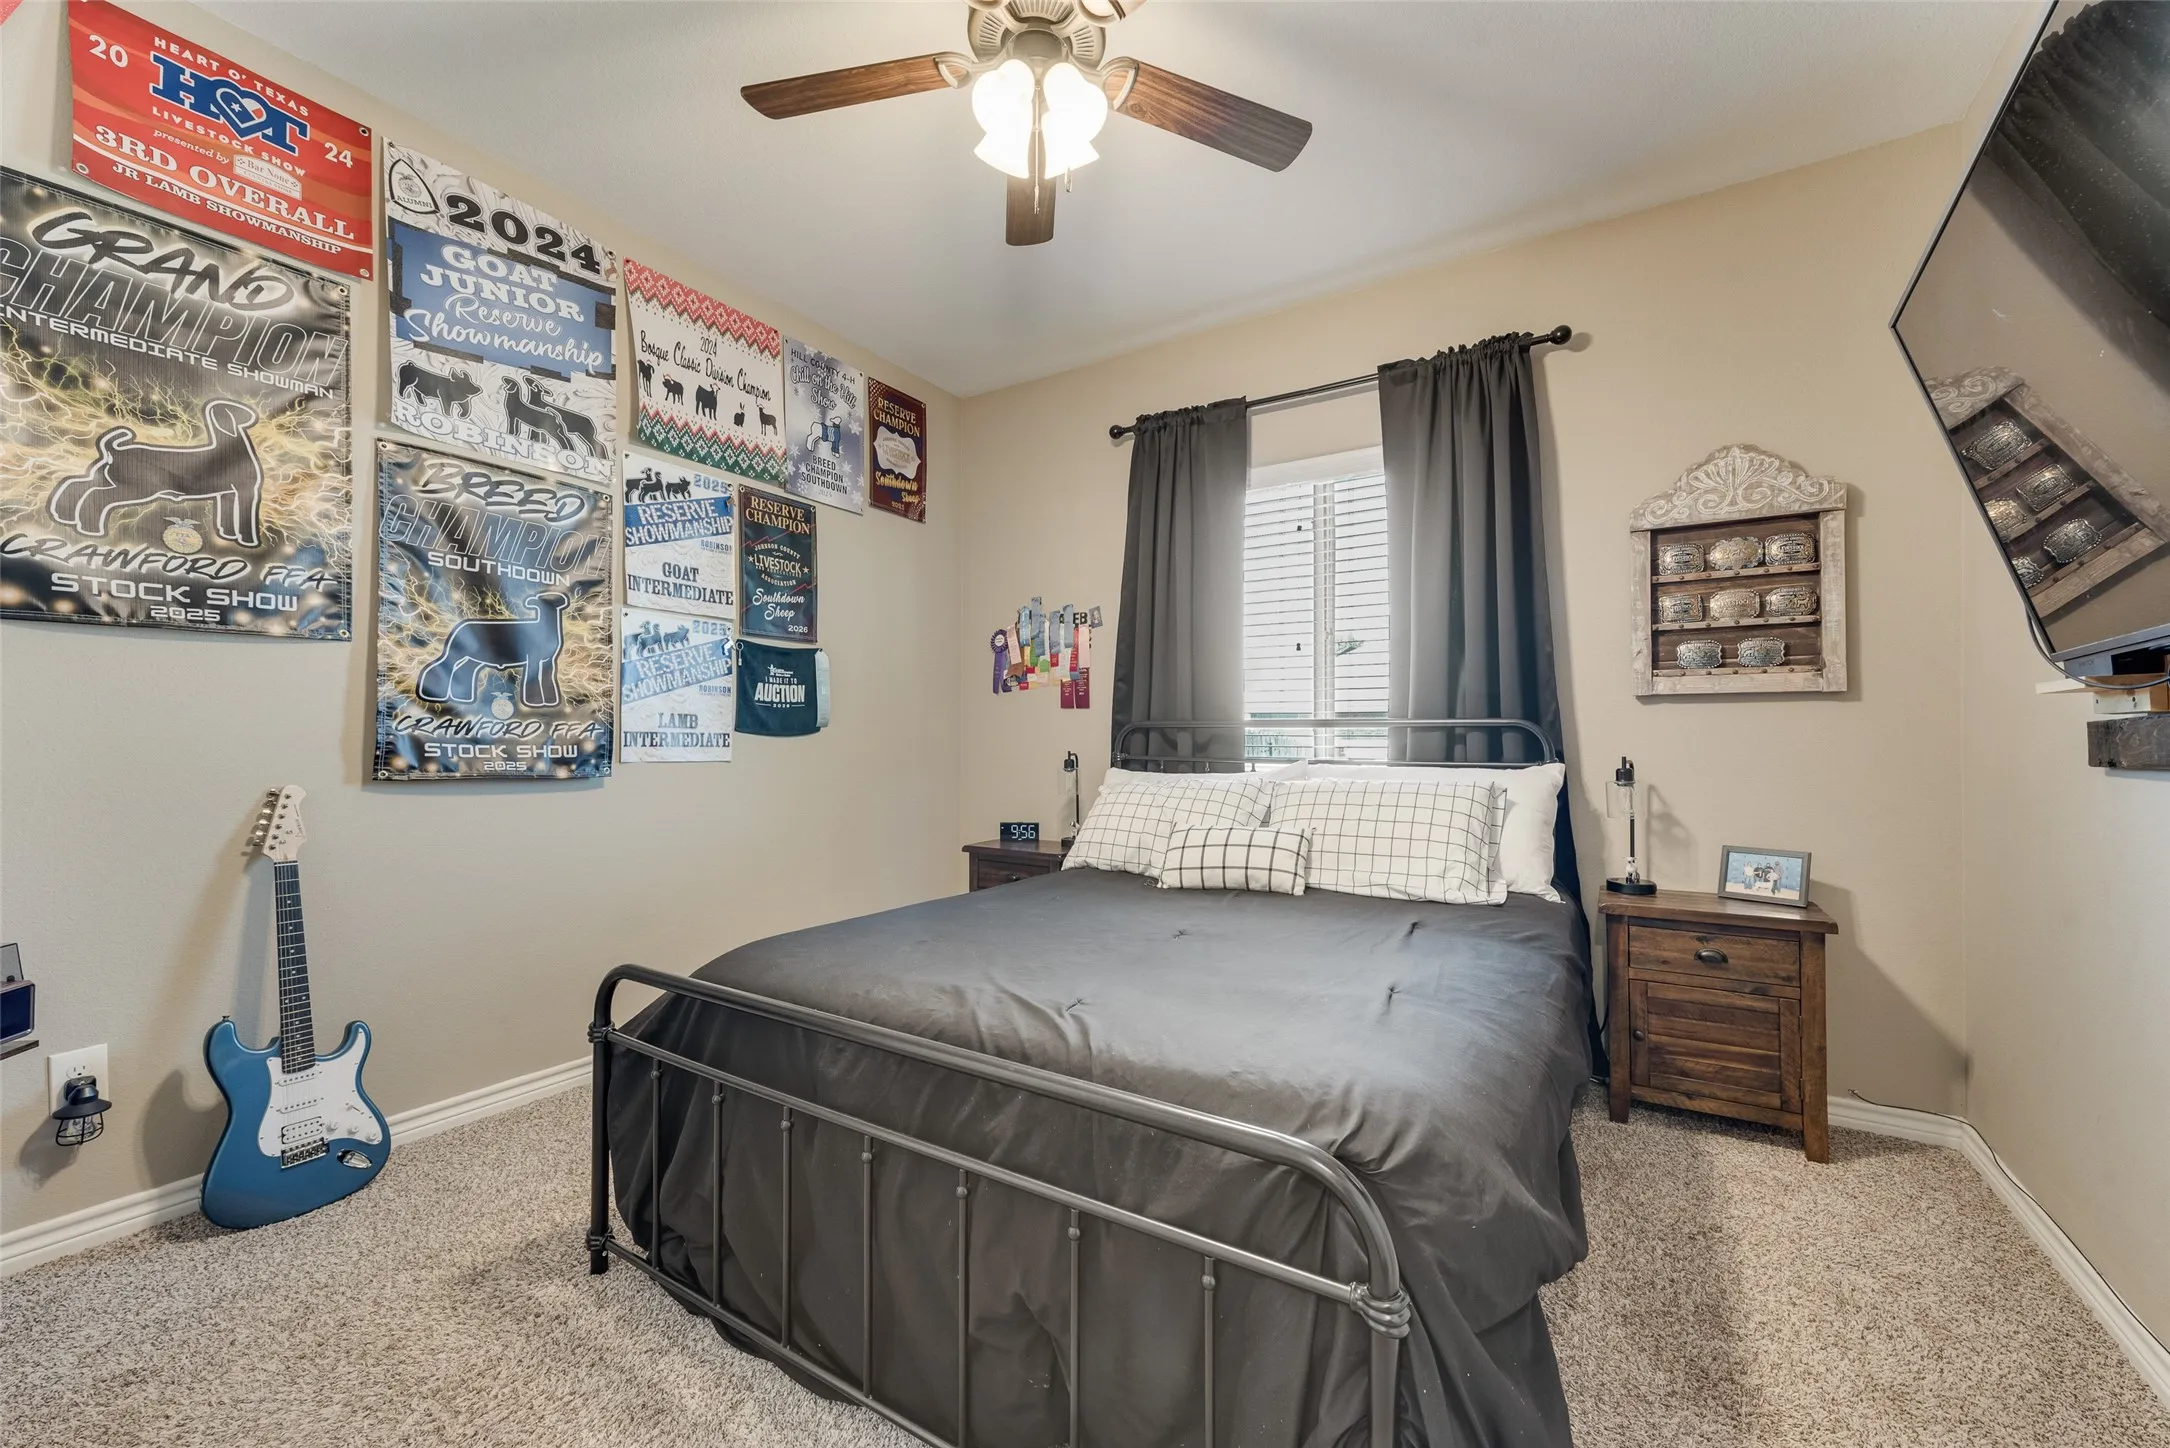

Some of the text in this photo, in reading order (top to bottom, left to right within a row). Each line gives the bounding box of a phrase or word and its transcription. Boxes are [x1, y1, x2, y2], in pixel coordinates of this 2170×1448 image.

[89, 34, 128, 68] 20
[154, 36, 220, 71] HEART
[254, 79, 309, 117] TEXAS
[152, 106, 306, 177] LIVESTOCK SHOW
[153, 128, 229, 164] presented by
[324, 142, 354, 169] 24
[94, 125, 354, 240] 3RD OVERALL
[247, 160, 290, 184] Bar None
[111, 162, 343, 254] JR LAMB SHOWMANSHIP
[397, 196, 433, 208] ALUMNI
[446, 194, 600, 275] 2024
[30, 207, 296, 312] GRAND
[441, 245, 558, 292] GOAT
[420, 264, 584, 322] JUNIOR
[445, 294, 562, 336] Reserve
[0, 302, 334, 400] NTERMEDIATE SHOWMAN
[404, 309, 603, 375] Showmanship
[700, 337, 717, 357] 2024
[641, 330, 771, 402] Bosque Classic Division Champion
[790, 365, 810, 384] Chill
[824, 375, 839, 394] the
[791, 348, 855, 384] HILL COUNTY 4-H
[811, 387, 837, 410] Show
[878, 397, 916, 423] RESERVE
[392, 398, 616, 476] ROBINSON
[873, 409, 920, 437] CHAMPION
[806, 463, 843, 483] CHAMPION
[813, 455, 835, 470] BREED
[414, 461, 586, 523] BREED
[694, 474, 727, 494] 2025
[802, 472, 847, 494] SOUTHDOWN
[637, 499, 718, 525] RESERVE
[745, 508, 810, 534] CHAMPION
[751, 497, 805, 521] RESERVE
[379, 495, 611, 577] CHAMPION
[626, 517, 733, 546] SHOWMANSHIP
[0, 533, 339, 592] CRAWFORD FFA
[428, 552, 570, 587] SOUTHDOWN
[662, 562, 699, 582] GOAT
[754, 554, 801, 573] LIVESTOCK
[51, 572, 297, 611] STOCK SHOW
[628, 574, 733, 605] INTERMEDIATE
[752, 588, 805, 606] Southdown
[150, 605, 221, 622] 2025
[764, 604, 795, 621] Sheep
[636, 644, 717, 678] RESERVE
[624, 658, 732, 701] SHOWMANSHIP
[755, 682, 805, 703] AUCTION
[395, 715, 603, 738] CRAWFORD FFA
[658, 713, 698, 728] LAMB
[425, 743, 577, 758] STOCK SHOW
[623, 731, 730, 748] INTERMEDIATE
[484, 762, 527, 771] 2025
[1011, 824, 1036, 839] 9:56
